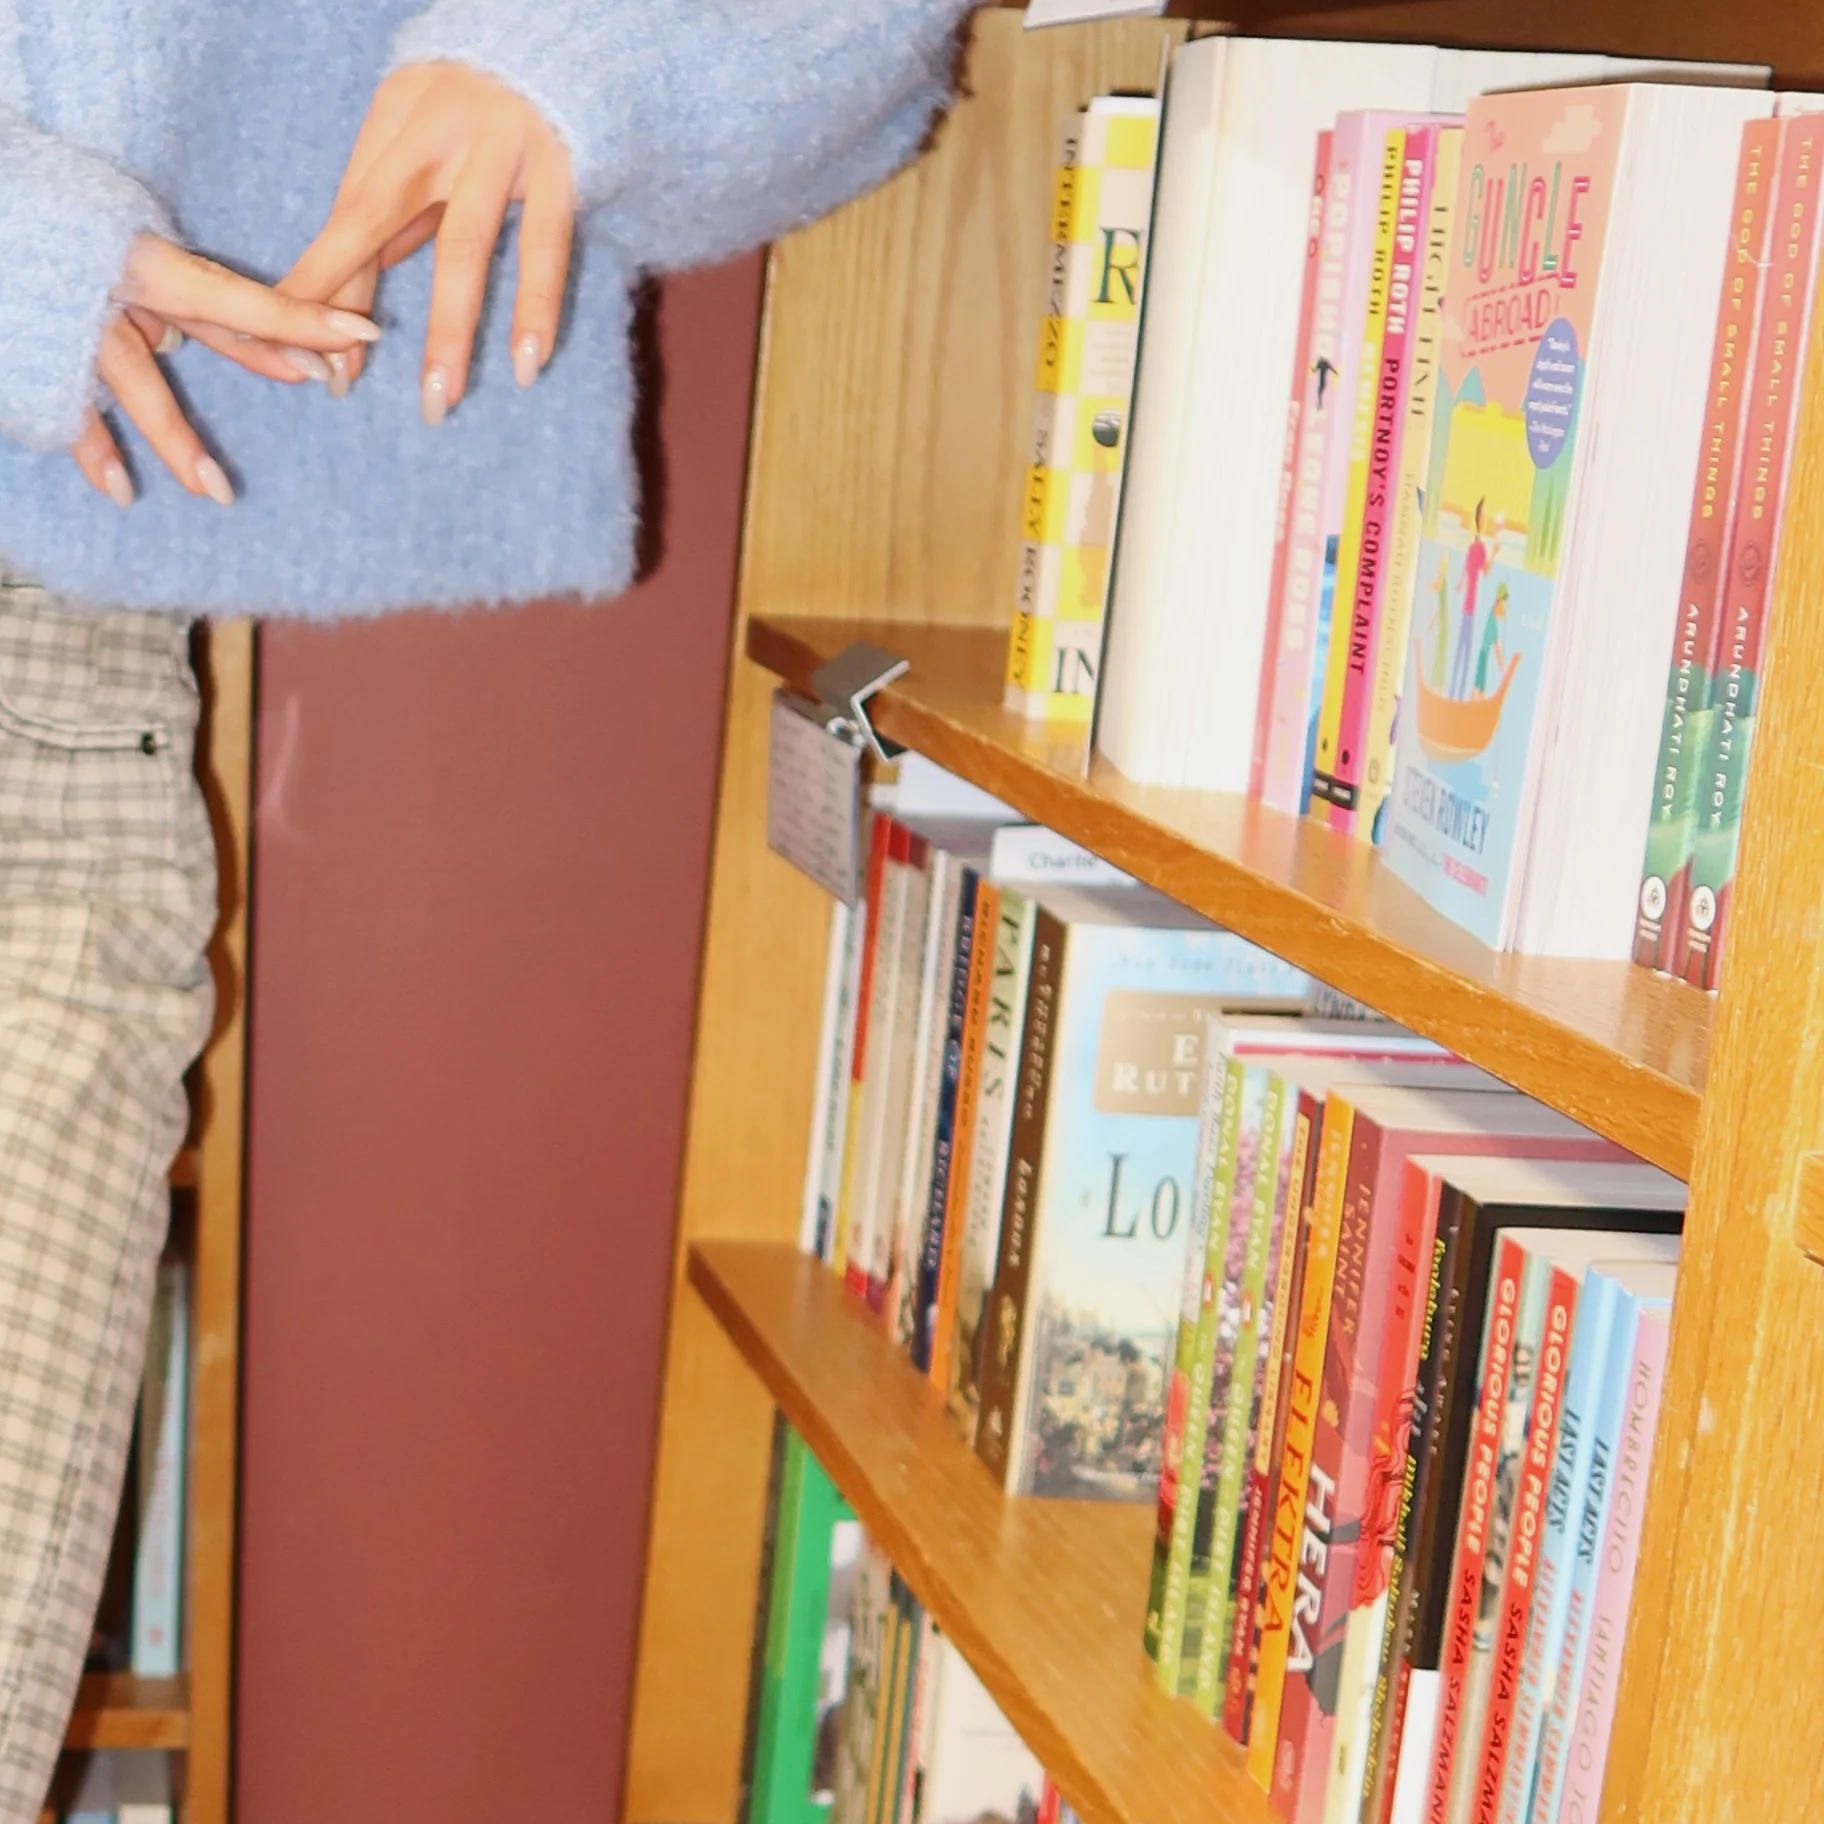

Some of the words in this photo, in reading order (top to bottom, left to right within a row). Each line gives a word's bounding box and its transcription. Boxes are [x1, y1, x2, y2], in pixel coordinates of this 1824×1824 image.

[1378, 145, 1398, 235] PHILIP
[1395, 158, 1424, 253] PHILIP
[1744, 144, 1763, 196] THE
[1795, 136, 1813, 189] THE
[1038, 134, 1083, 378] INTERMEZZO
[1462, 161, 1593, 292] GUNCLE
[1736, 208, 1754, 264] GOD
[1787, 202, 1805, 258] GOD
[1368, 248, 1387, 316] ROTH
[1386, 263, 1412, 335] ROTH
[1466, 286, 1560, 348] ABROAD
[1716, 323, 1738, 409] SMALL
[1766, 320, 1789, 407] SMALL
[1368, 357, 1401, 508] PORTNOY'S
[1702, 420, 1725, 519] THINGS
[1753, 419, 1776, 520] THINGS
[1008, 542, 1042, 689] ROONEY
[1350, 520, 1382, 675] COMPLAINT
[1668, 603, 1700, 755] ARUNDHATI
[1718, 605, 1749, 761] ARUNDHATI
[1661, 765, 1678, 823] ROY
[1711, 771, 1727, 829] ROY
[981, 911, 1020, 1099] PARIS
[1214, 1072, 1238, 1187] DONAL
[1254, 1089, 1279, 1190] DONAL
[1205, 1192, 1225, 1254] RYAN
[1245, 1201, 1265, 1269] RYAN
[1331, 1201, 1356, 1300] SAINT
[1341, 1184, 1373, 1337] JENNIFER
[1470, 1276, 1517, 1439] GLORIOUS
[1529, 1304, 1569, 1473] GLORIOUS
[1261, 1370, 1314, 1636] ELEKTRA
[1464, 1442, 1497, 1553] PEOPLE
[1513, 1474, 1543, 1590] PEOPLE
[1283, 1462, 1337, 1678] HERA
[1449, 1567, 1478, 1667] SASHA
[1499, 1600, 1523, 1699] SASHA
